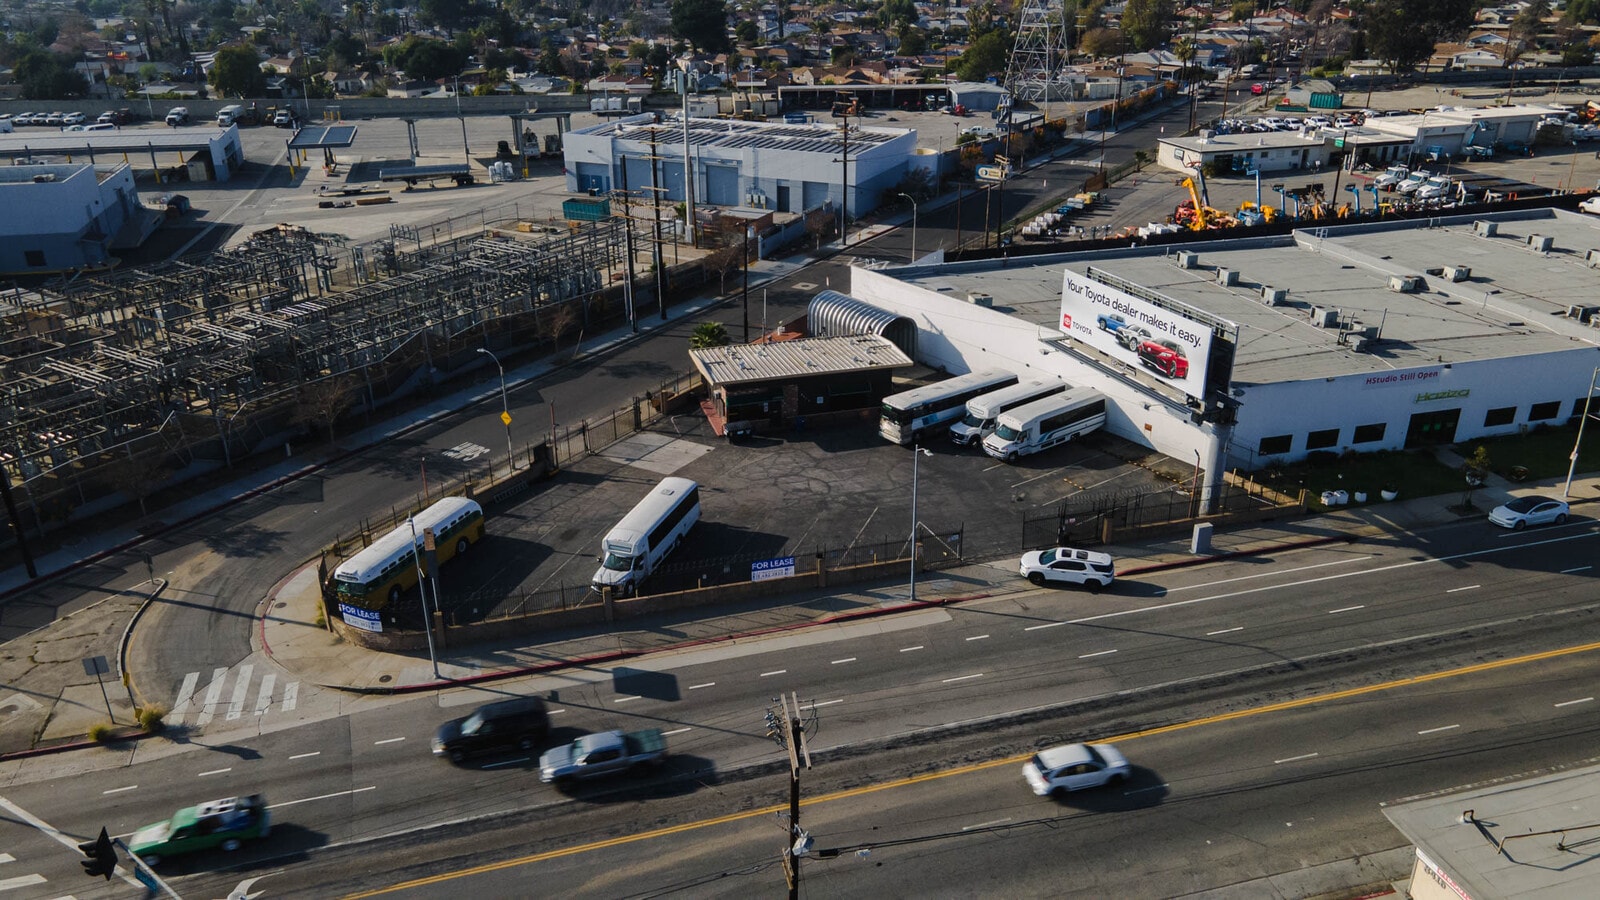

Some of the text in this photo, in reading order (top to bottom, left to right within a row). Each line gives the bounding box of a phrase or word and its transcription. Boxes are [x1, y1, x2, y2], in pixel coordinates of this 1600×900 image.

[1067, 278, 1202, 348] Your Toyota dealer makes it easy.
[1072, 322, 1092, 336] TOYOTA
[1366, 371, 1438, 385] HStudio Still Open
[770, 558, 793, 568] LEASE
[342, 604, 380, 620] FOR LEASE
